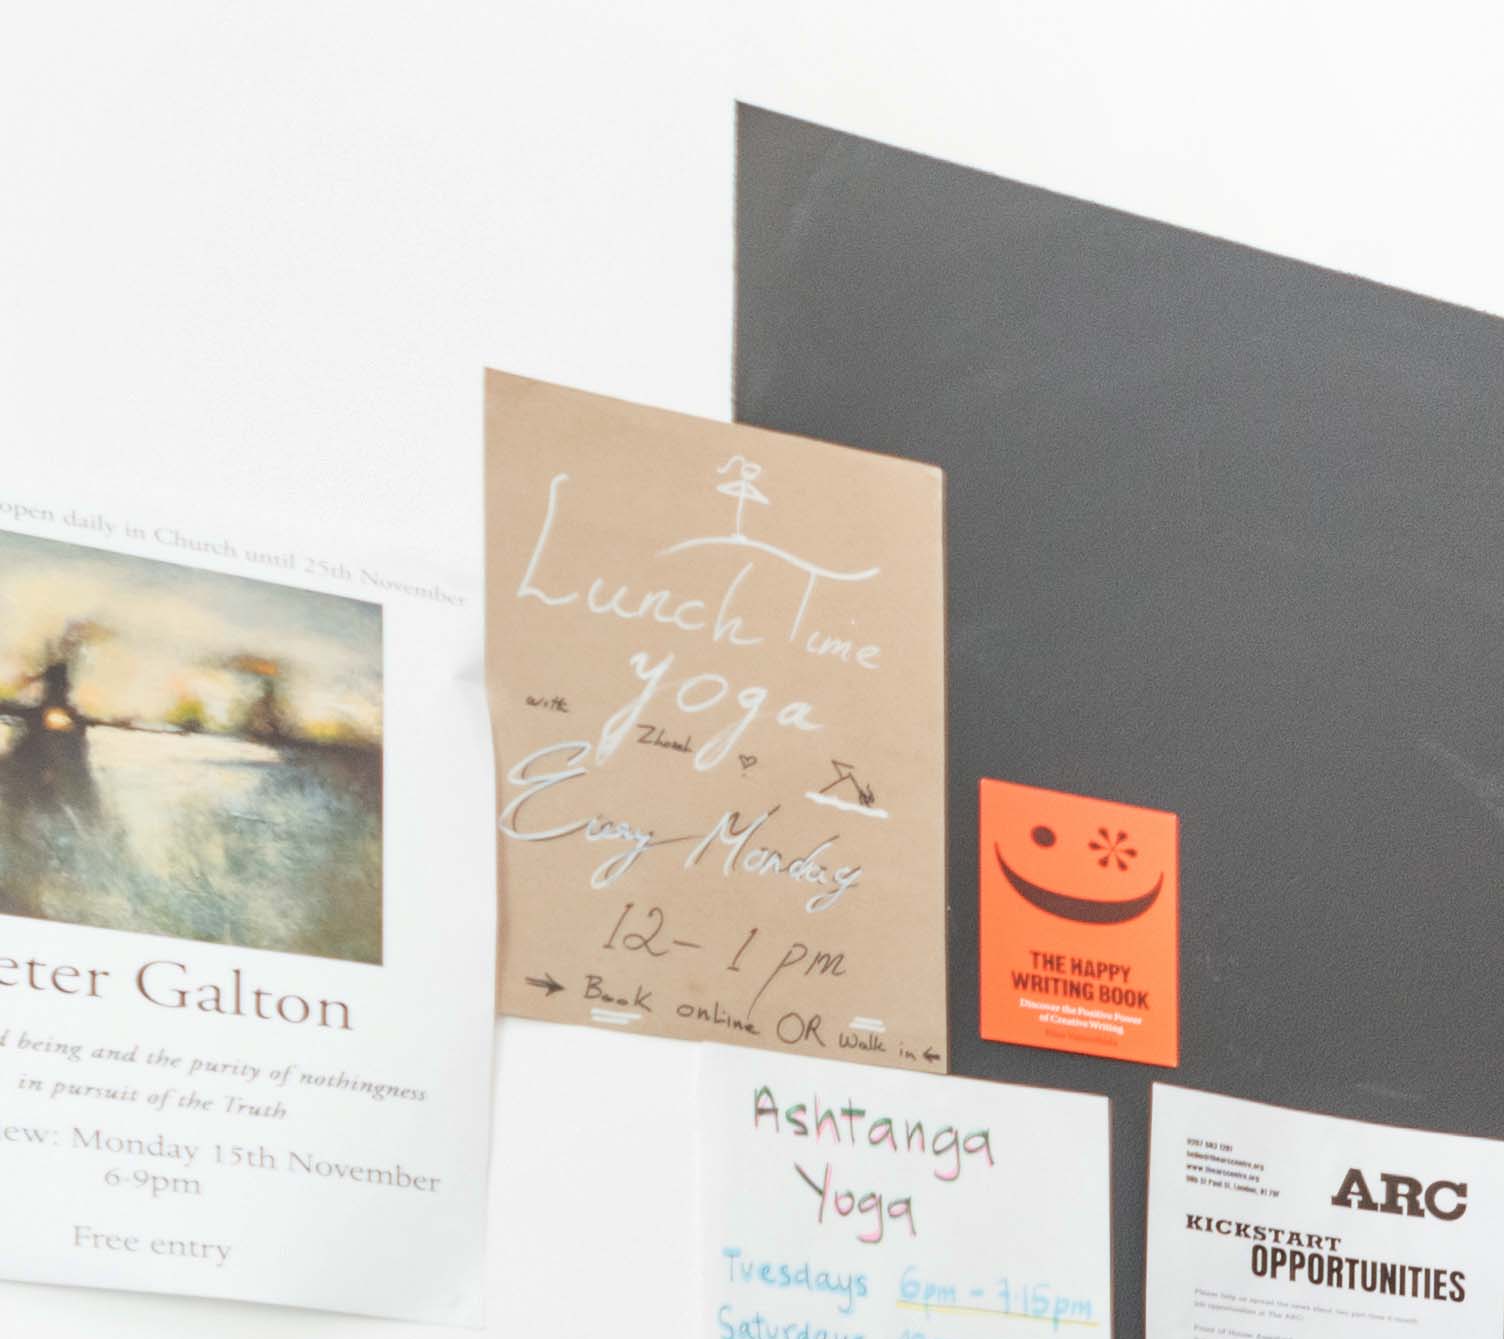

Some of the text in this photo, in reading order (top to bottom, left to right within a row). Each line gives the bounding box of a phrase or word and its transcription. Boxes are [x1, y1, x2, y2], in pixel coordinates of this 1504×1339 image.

[63, 508, 116, 538] daily
[125, 522, 147, 541] in
[154, 527, 238, 560] Church
[245, 546, 295, 570] until
[303, 557, 352, 582] 25th
[360, 568, 467, 608] November
[516, 472, 765, 645] Lunch
[499, 742, 657, 890] Every
[683, 803, 864, 913] Monday
[136, 960, 355, 1032] Galton
[1010, 969, 1151, 1011] WRITING BOOK
[1029, 950, 1132, 984] THE HAPPY
[584, 974, 652, 1014] Book
[776, 1012, 827, 1050] OR
[18, 1030, 428, 1103] being and the purity of nothingness
[18, 1073, 288, 1121] in pursuit of the Truth
[72, 1125, 442, 1193] Monday 15th November
[752, 1084, 997, 1183] Ashtanga
[104, 1167, 202, 1199] 6-9pm
[793, 1161, 918, 1245] Yoga
[1331, 1166, 1469, 1222] ARC
[73, 1224, 234, 1268] Free entry
[1184, 1213, 1343, 1252] KICKSTART
[720, 1247, 958, 1318] Tuesdays 6pm
[1250, 1243, 1467, 1304] OPPORTUNITIES
